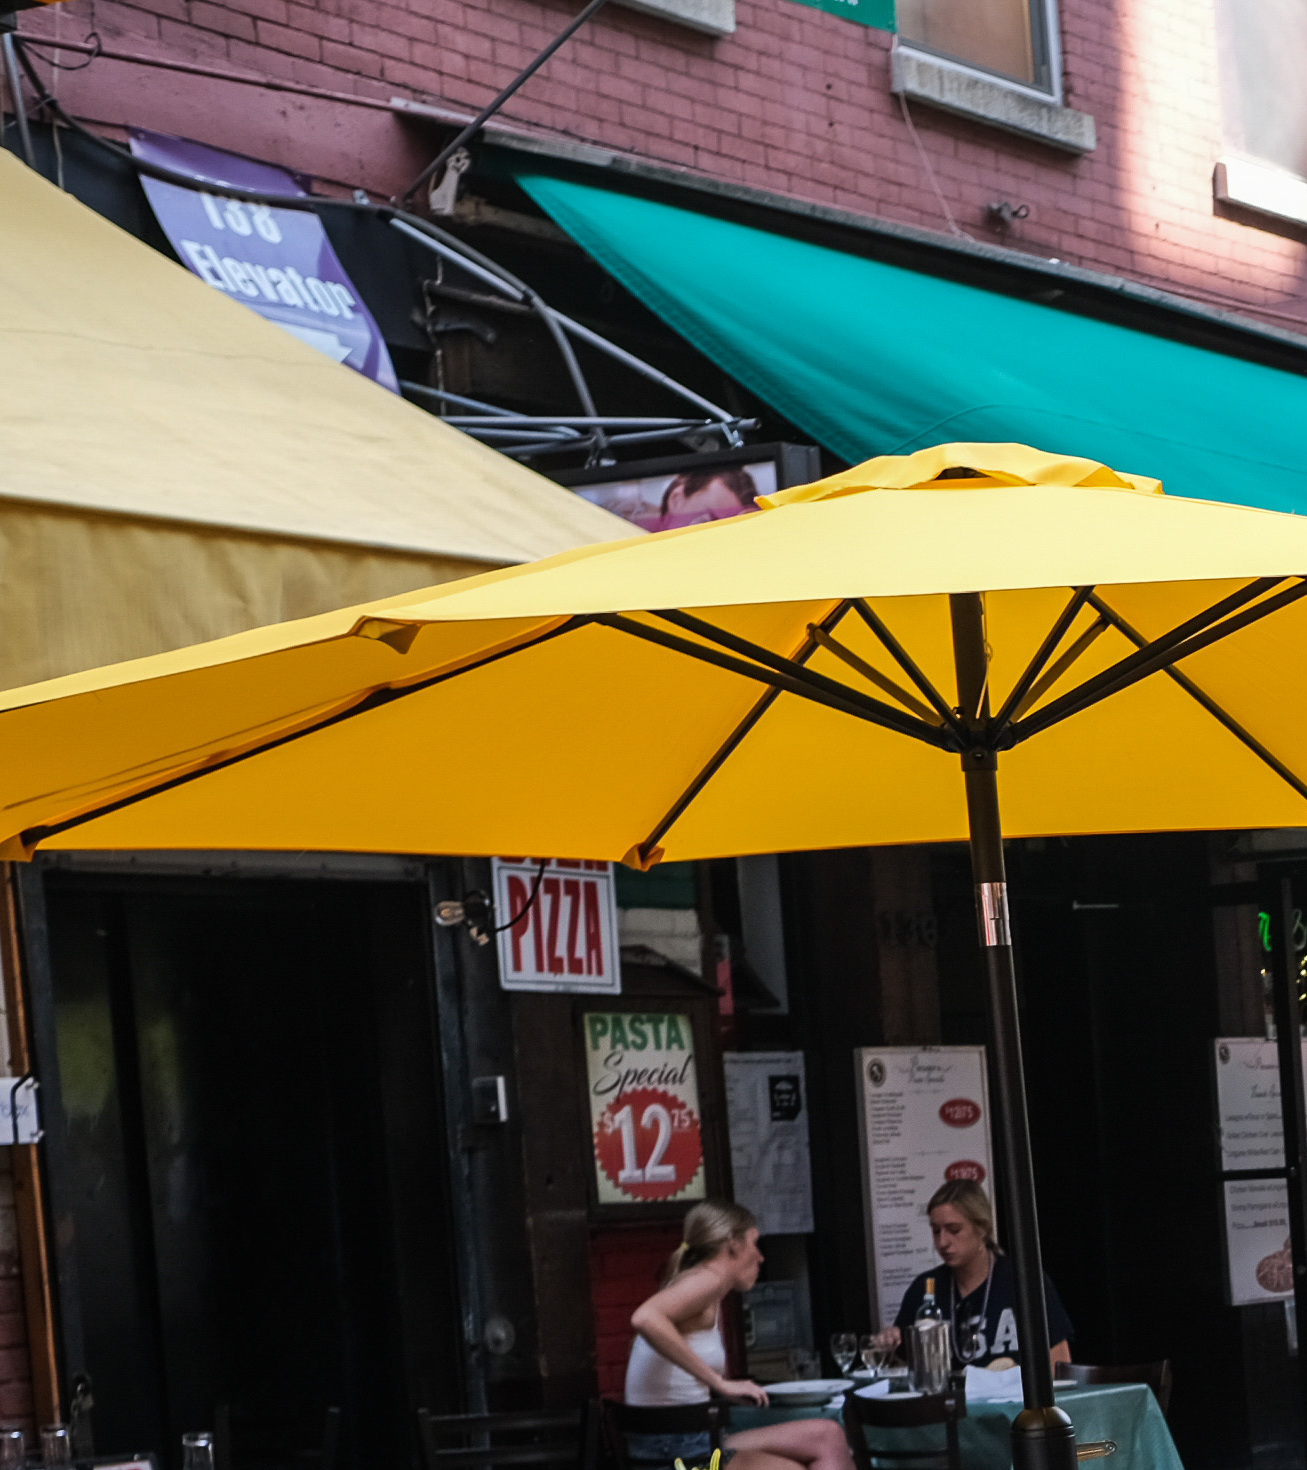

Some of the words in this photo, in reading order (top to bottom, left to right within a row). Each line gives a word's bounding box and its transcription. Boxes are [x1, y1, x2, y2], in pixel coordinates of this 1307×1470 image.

[180, 239, 356, 319] Elevator
[506, 874, 604, 977] PIZZA
[588, 1014, 685, 1051] PASTA
[592, 1051, 693, 1104] Special
